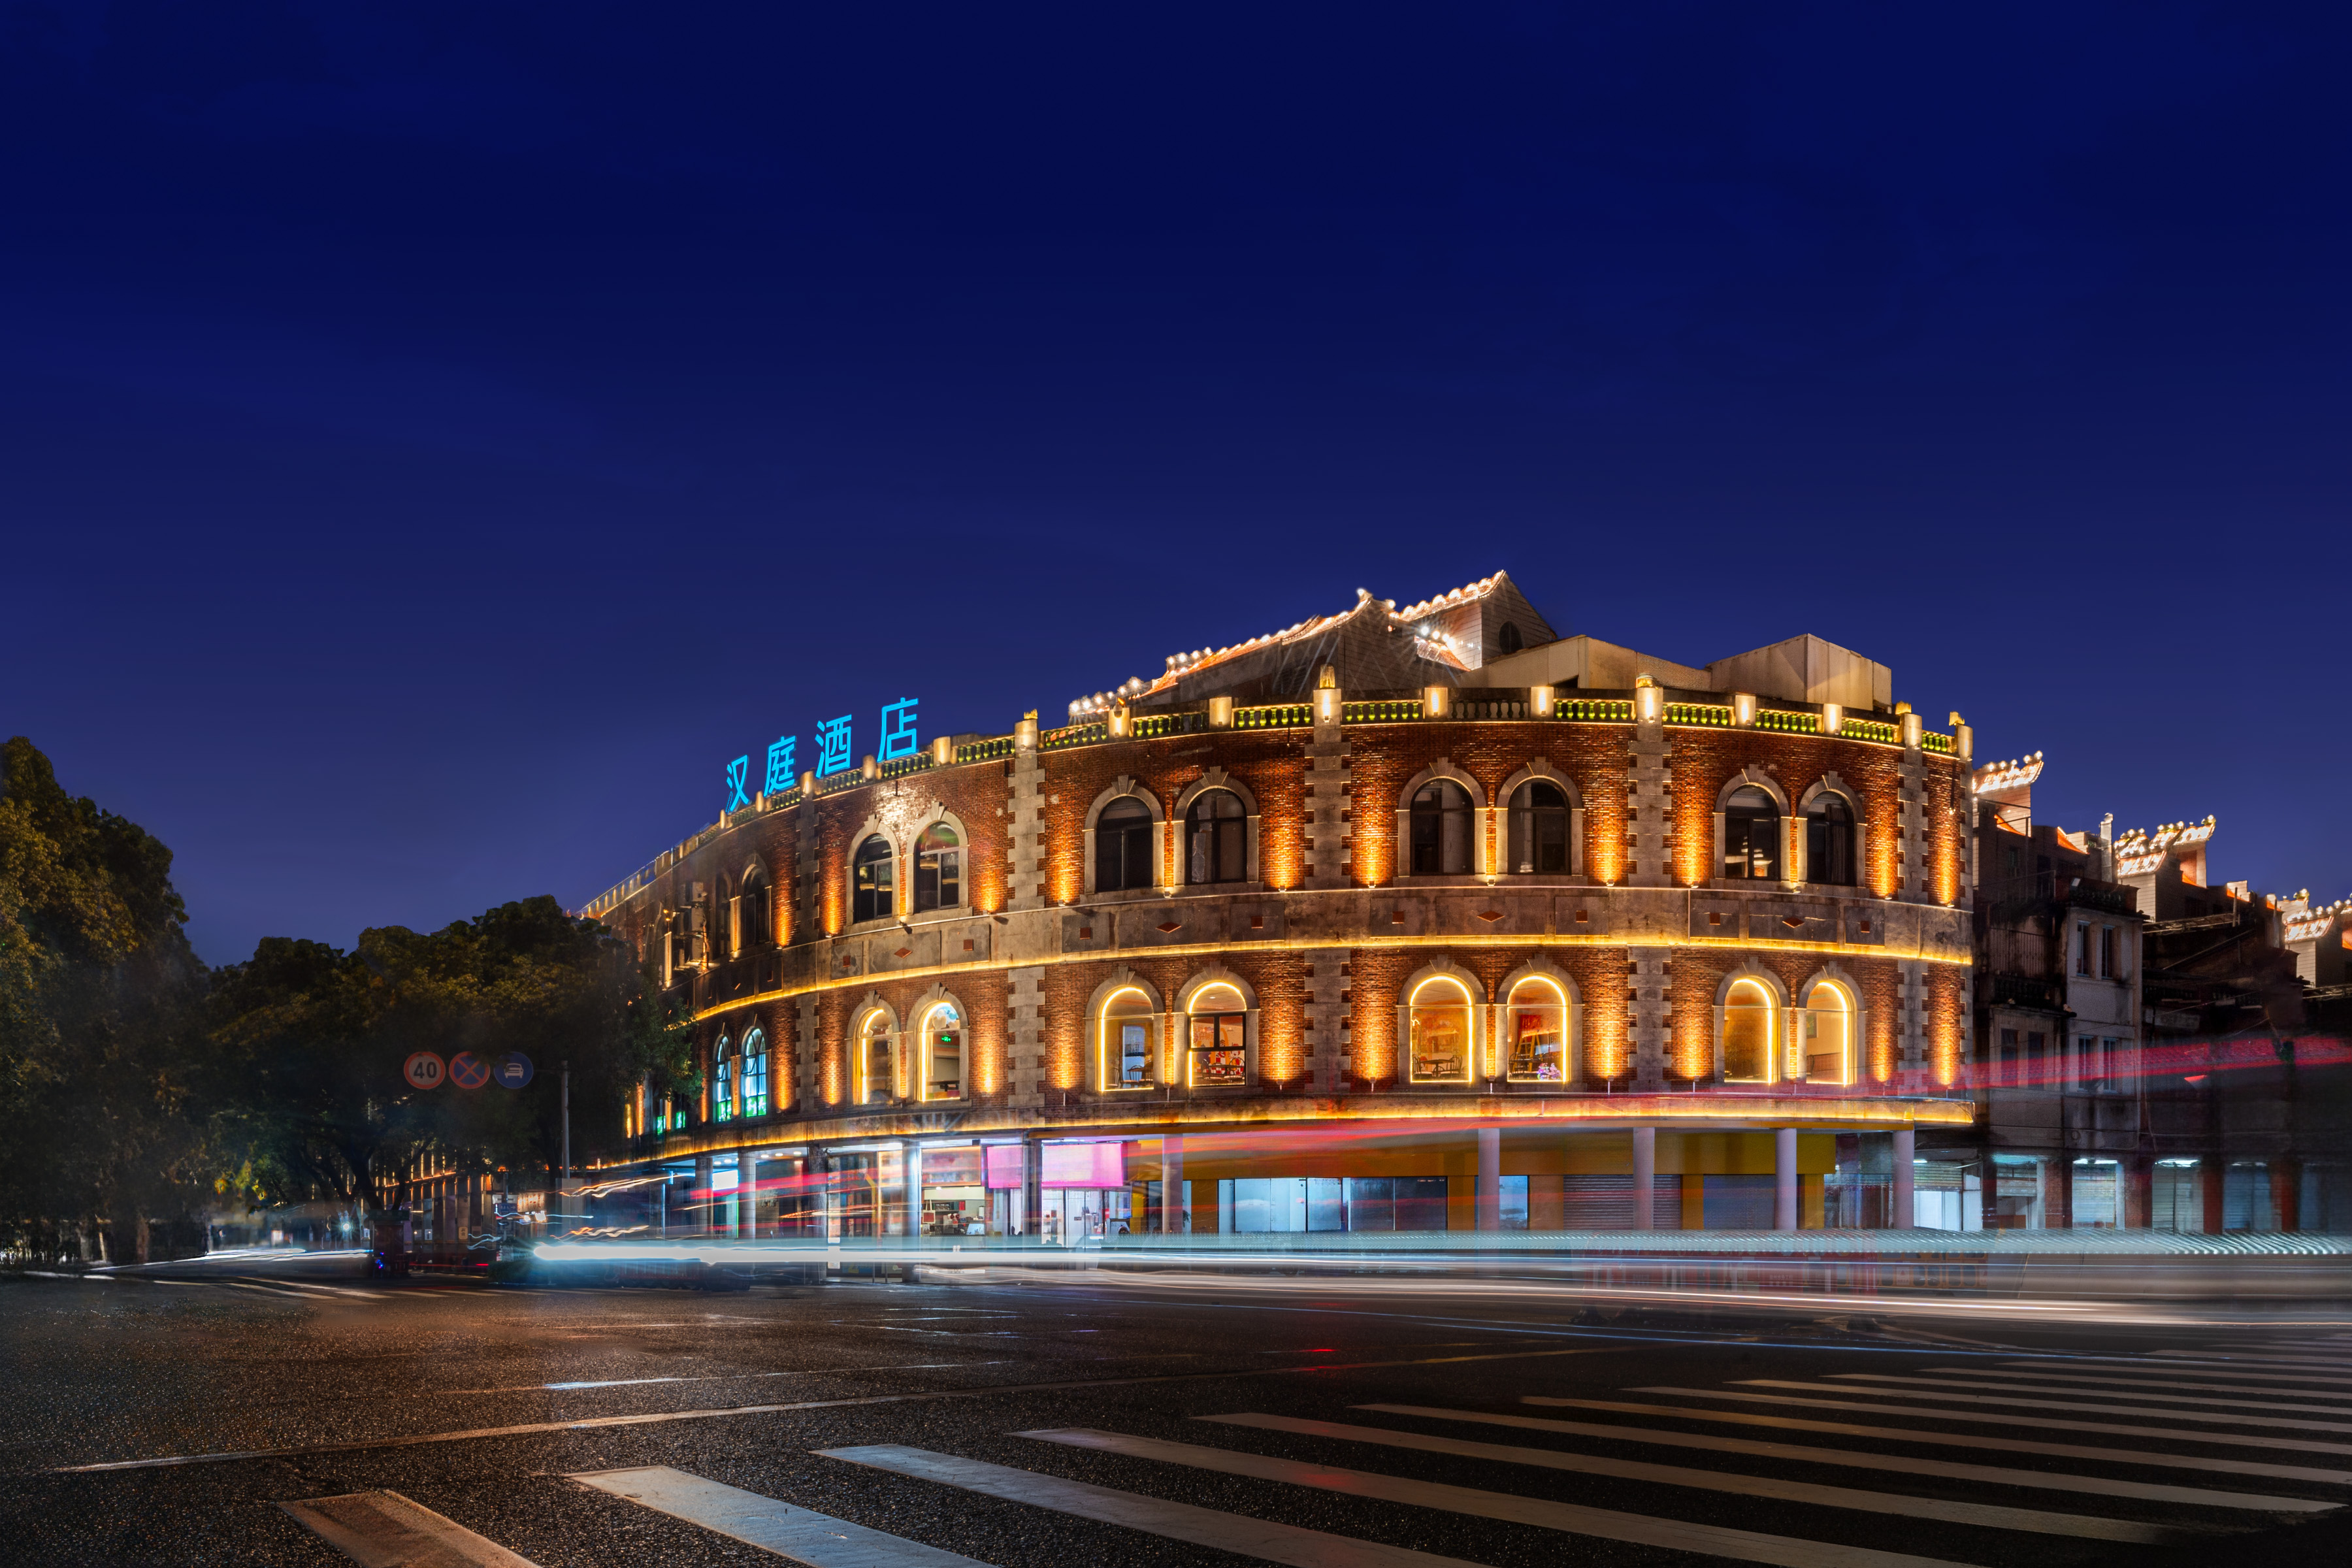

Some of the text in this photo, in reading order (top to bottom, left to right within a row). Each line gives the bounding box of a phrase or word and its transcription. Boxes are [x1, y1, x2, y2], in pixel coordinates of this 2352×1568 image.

[726, 697, 919, 813] 汉庭酒店
[414, 1062, 437, 1079] 40
